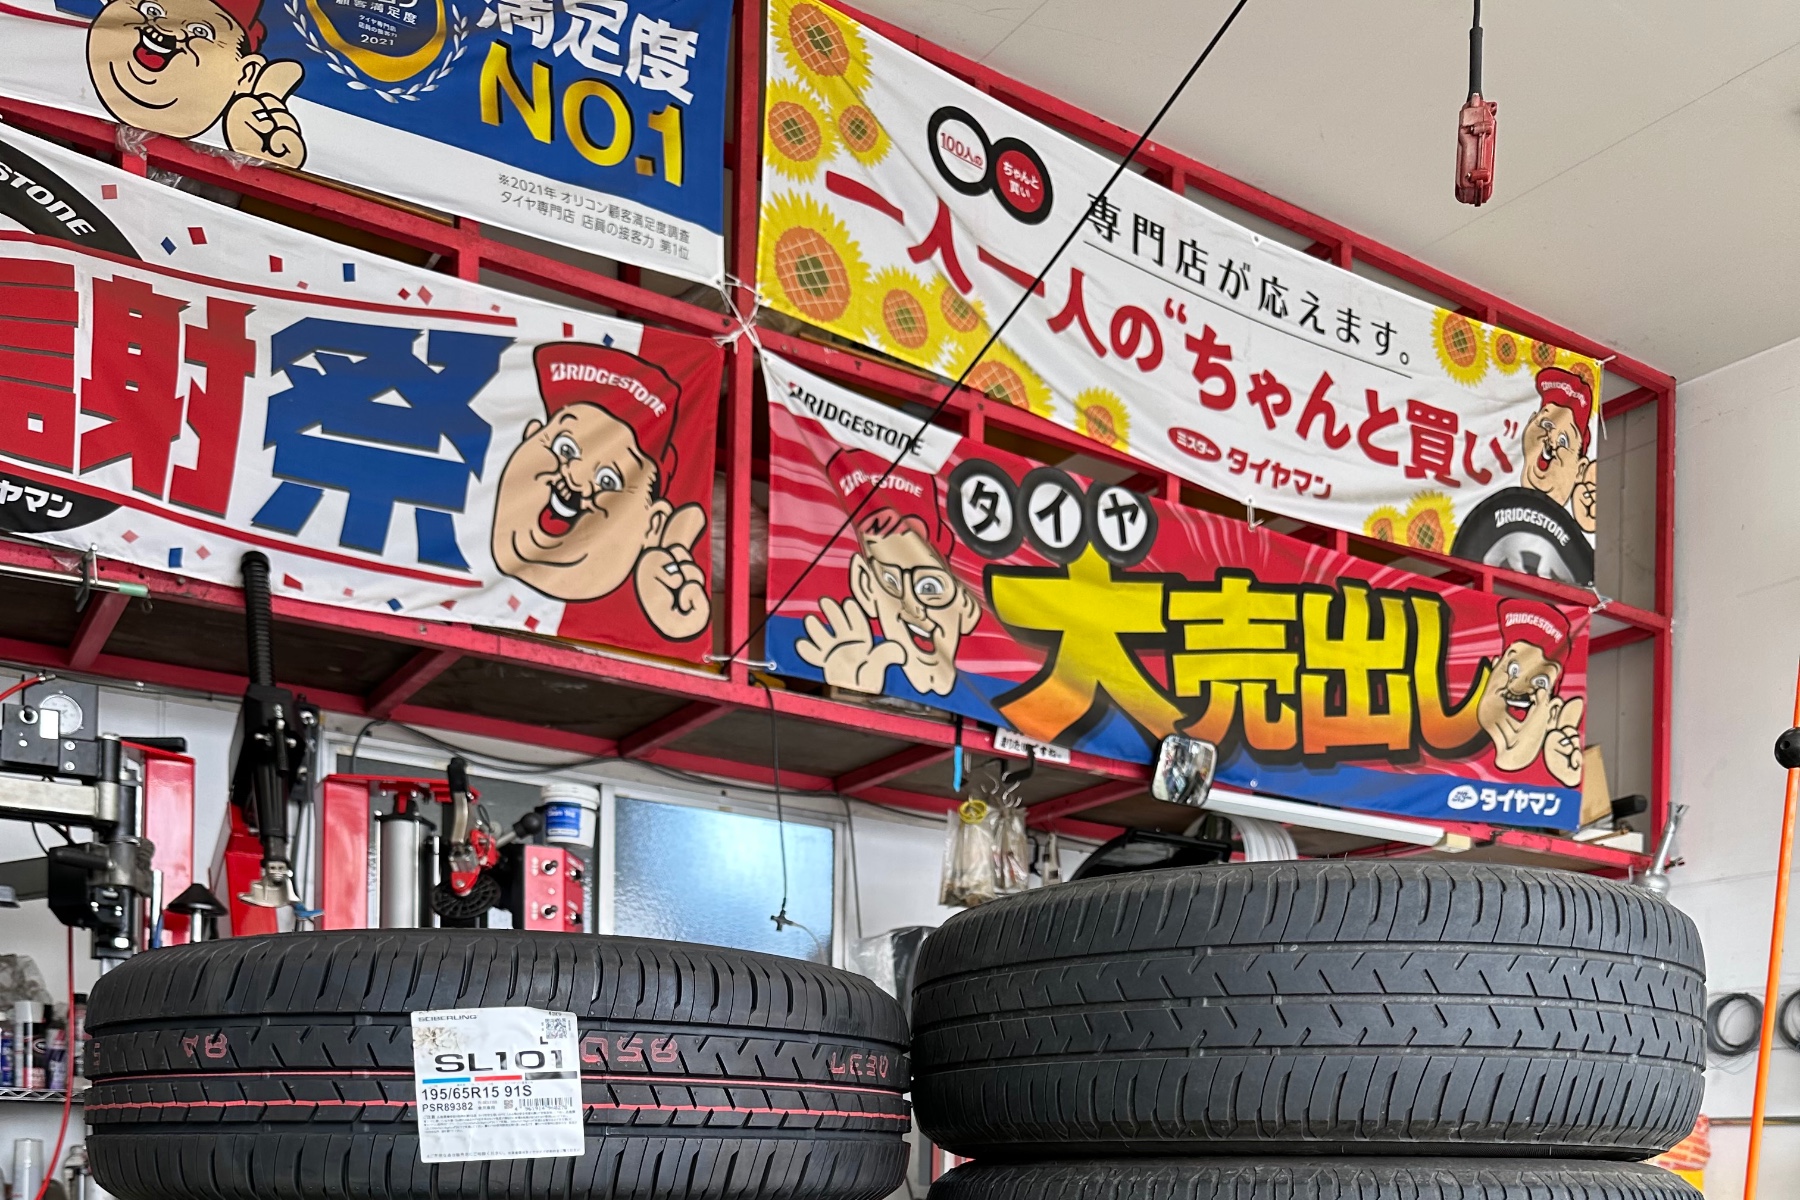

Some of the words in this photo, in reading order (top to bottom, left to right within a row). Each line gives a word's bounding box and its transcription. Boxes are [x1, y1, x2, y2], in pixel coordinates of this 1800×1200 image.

[360, 33, 395, 46] 2021
[480, 39, 684, 187] NO.1
[1003, 161, 1040, 190] ちゃんと
[1086, 192, 1413, 366] 専門店が応えます。
[550, 361, 668, 419] BRIDGESTONE
[788, 381, 926, 457] BRIDGESTONE
[1176, 430, 1217, 456] ミスター
[1227, 447, 1332, 500] タイヤマン
[968, 475, 1143, 550] タイヤ
[1495, 508, 1571, 547] BRIDGESTONE
[985, 540, 1490, 760] 大売出し
[1480, 788, 1561, 816] タイヤマン
[434, 1050, 564, 1073] SL101
[421, 1086, 500, 1101] 195/65R15
[504, 1084, 533, 1098] 91S
[422, 1101, 474, 1112] PSR89382
